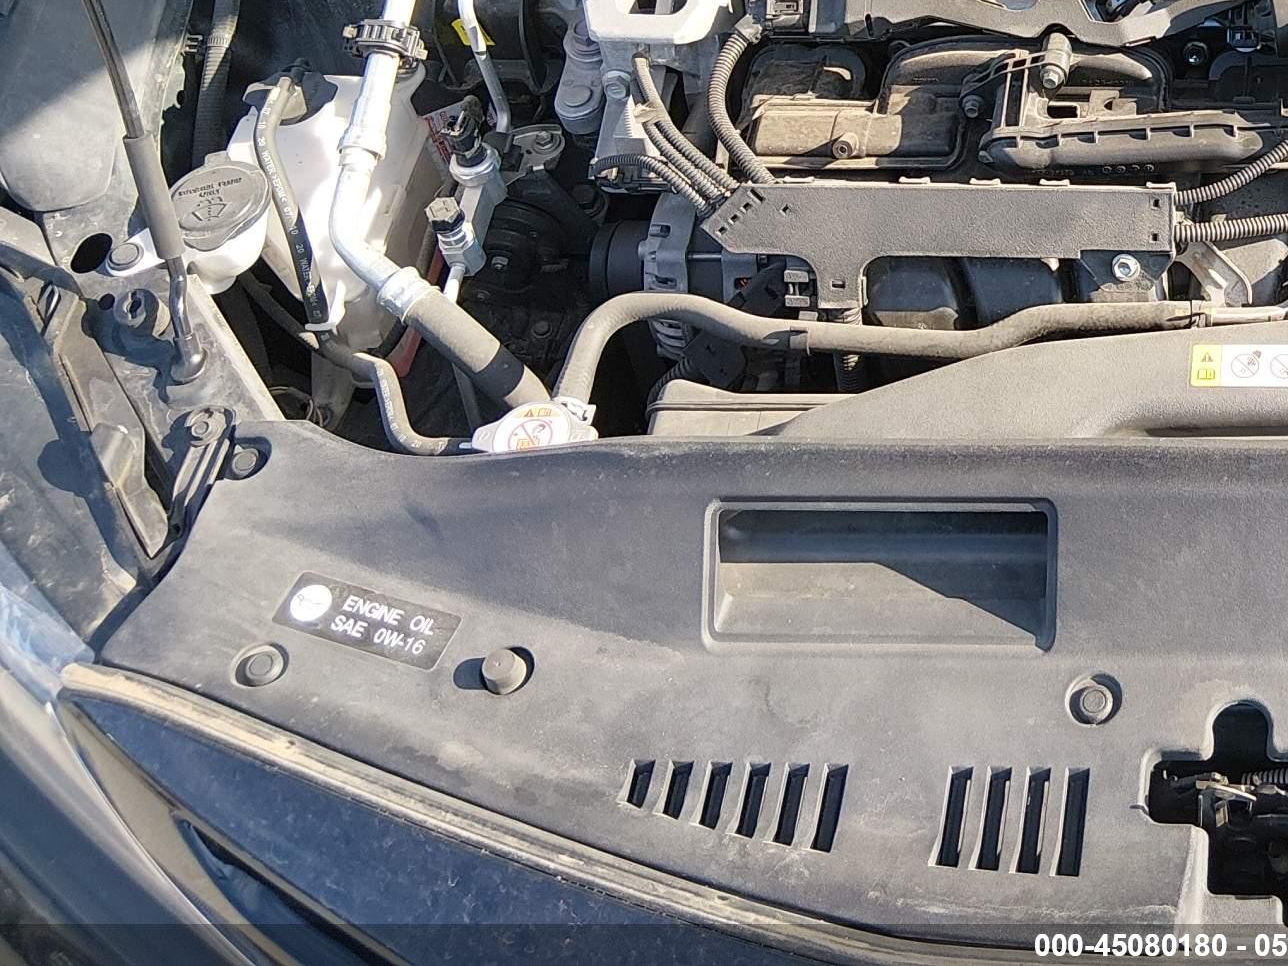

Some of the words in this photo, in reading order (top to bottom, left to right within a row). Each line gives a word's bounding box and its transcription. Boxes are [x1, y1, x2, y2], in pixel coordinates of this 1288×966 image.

[262, 150, 275, 176] WATER
[295, 244, 305, 254] 20
[331, 615, 368, 638] SAE
[373, 628, 426, 655] 0W-16
[342, 595, 405, 626] ENGINE
[410, 615, 434, 635] OIL
